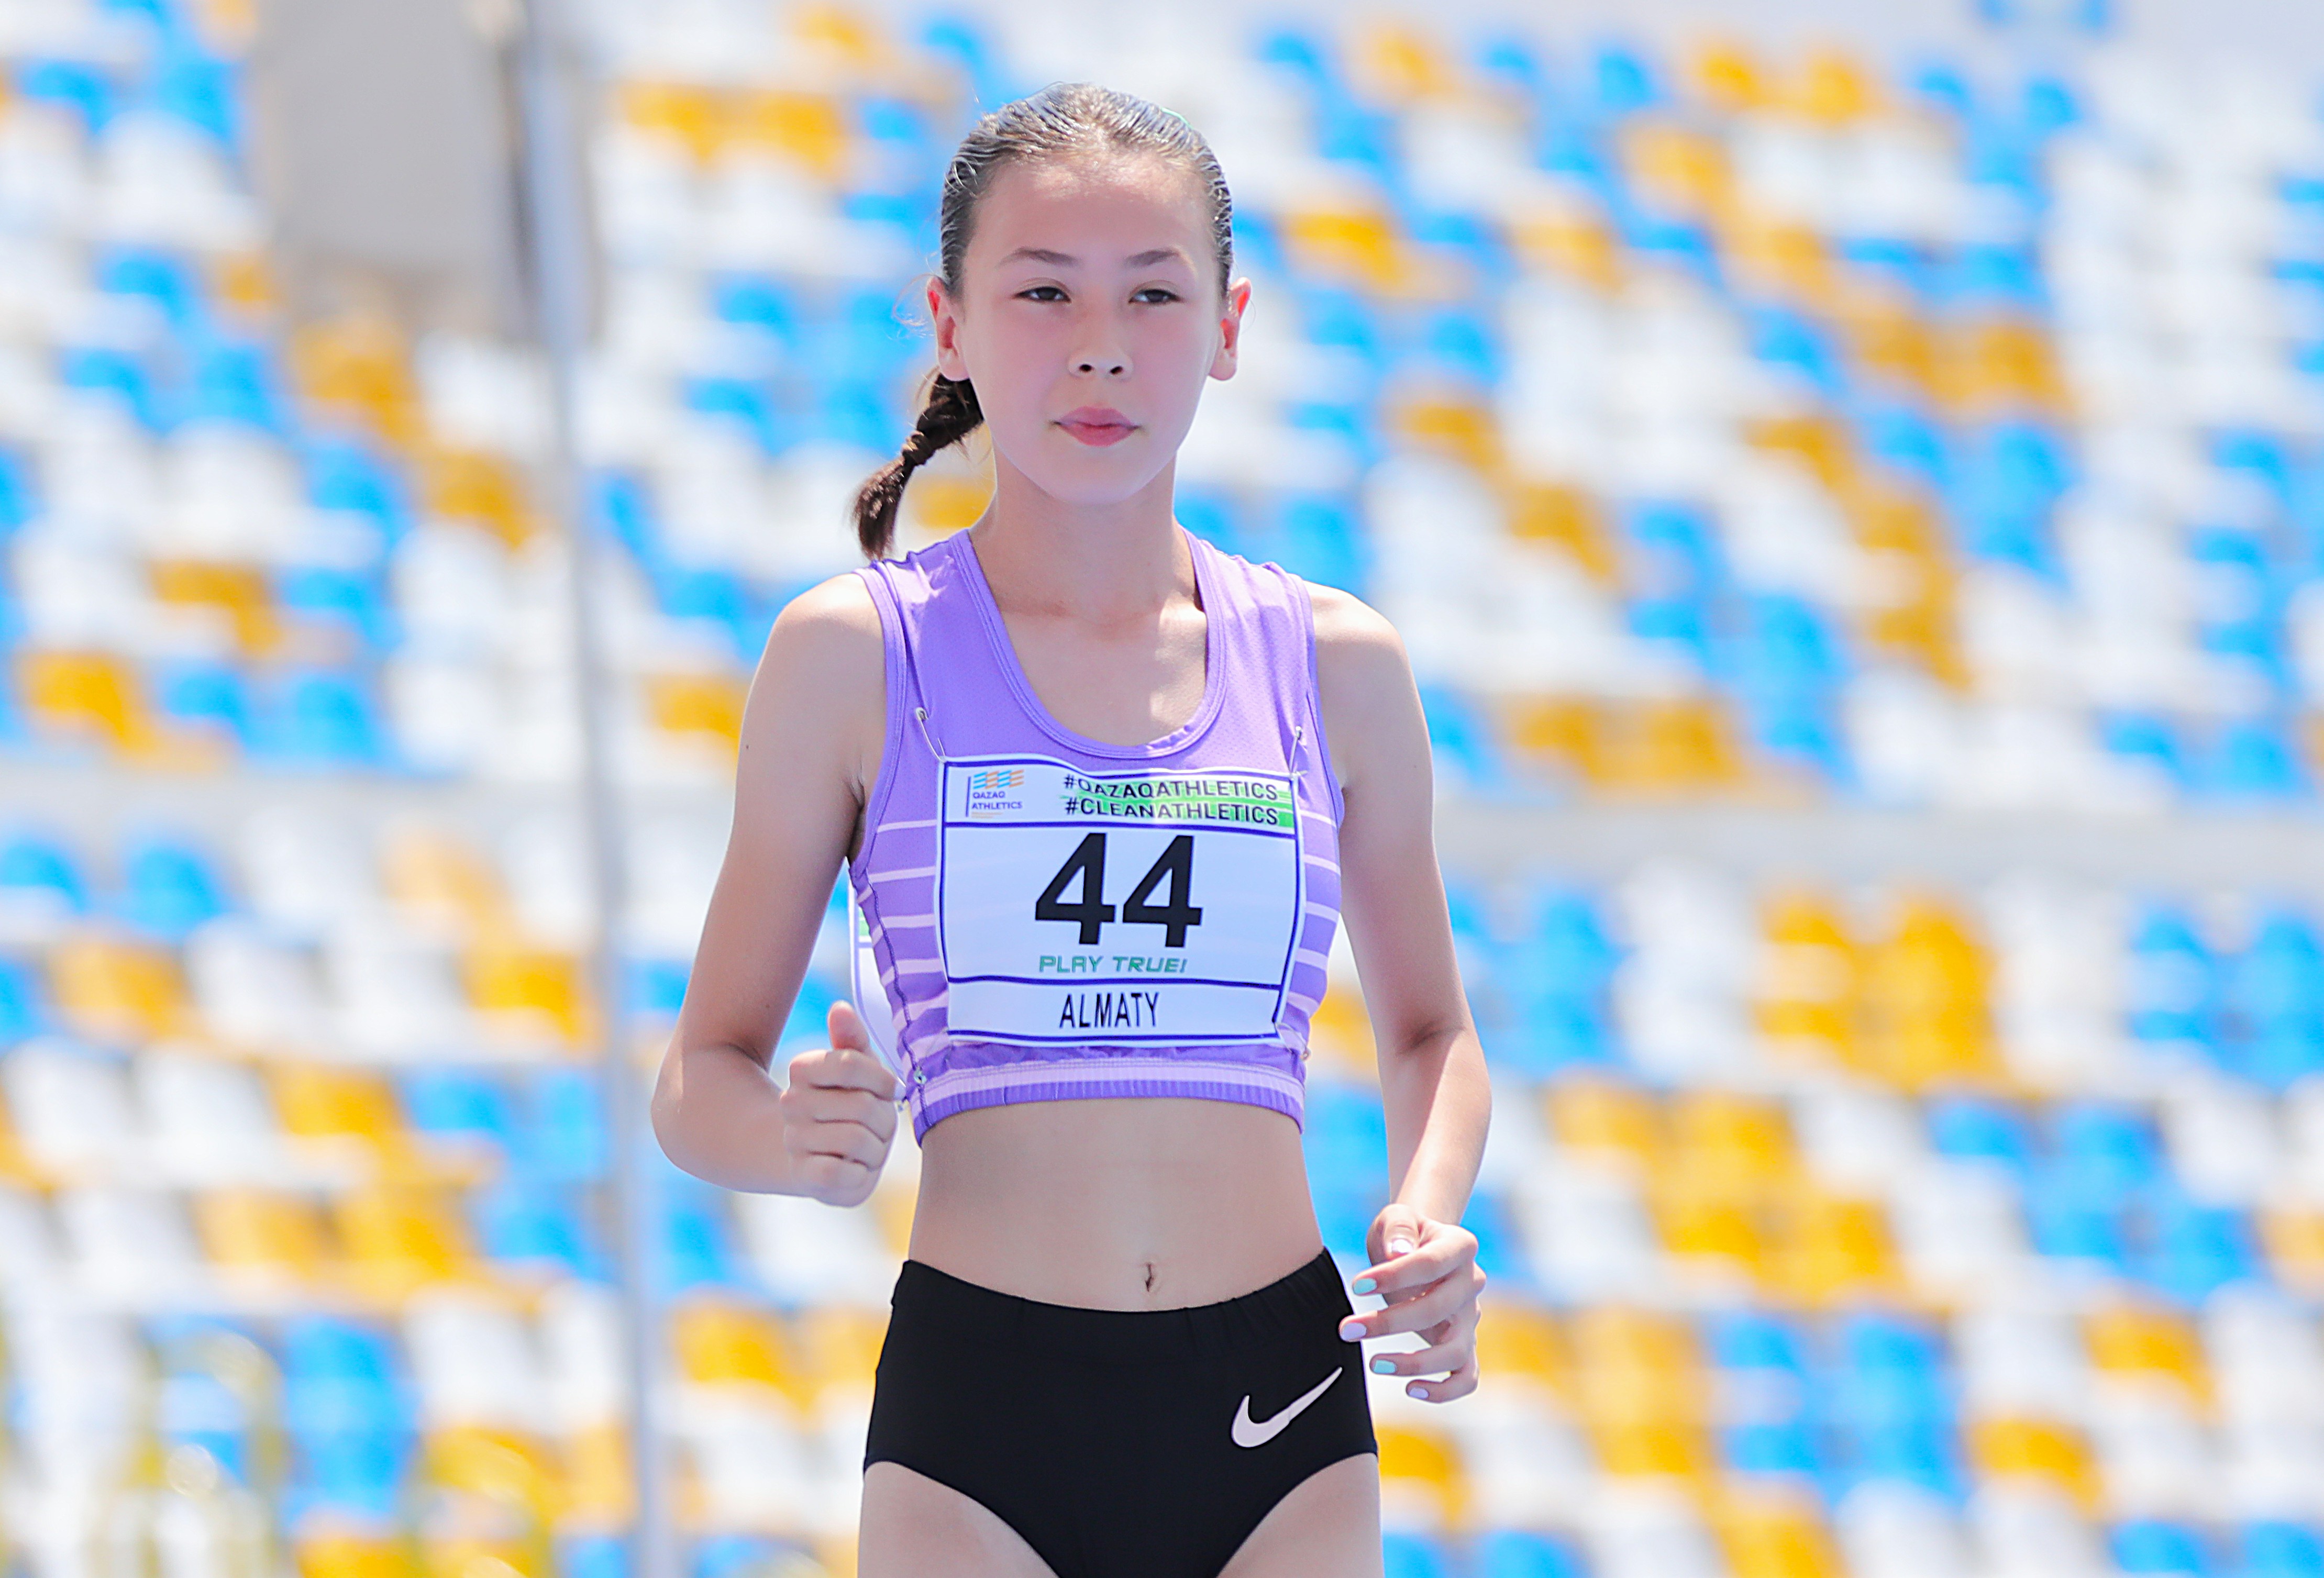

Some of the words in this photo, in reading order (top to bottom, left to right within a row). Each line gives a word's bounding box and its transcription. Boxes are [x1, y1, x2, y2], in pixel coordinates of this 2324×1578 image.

[1064, 774, 1278, 801] #QAZAQATHLETICS
[1065, 797, 1278, 825] #CLEANATHLETICS
[1035, 832, 1202, 948] 44
[1039, 956, 1104, 973] PLAY
[1112, 957, 1188, 974] TRUE!
[1059, 993, 1159, 1028] ALMATY
